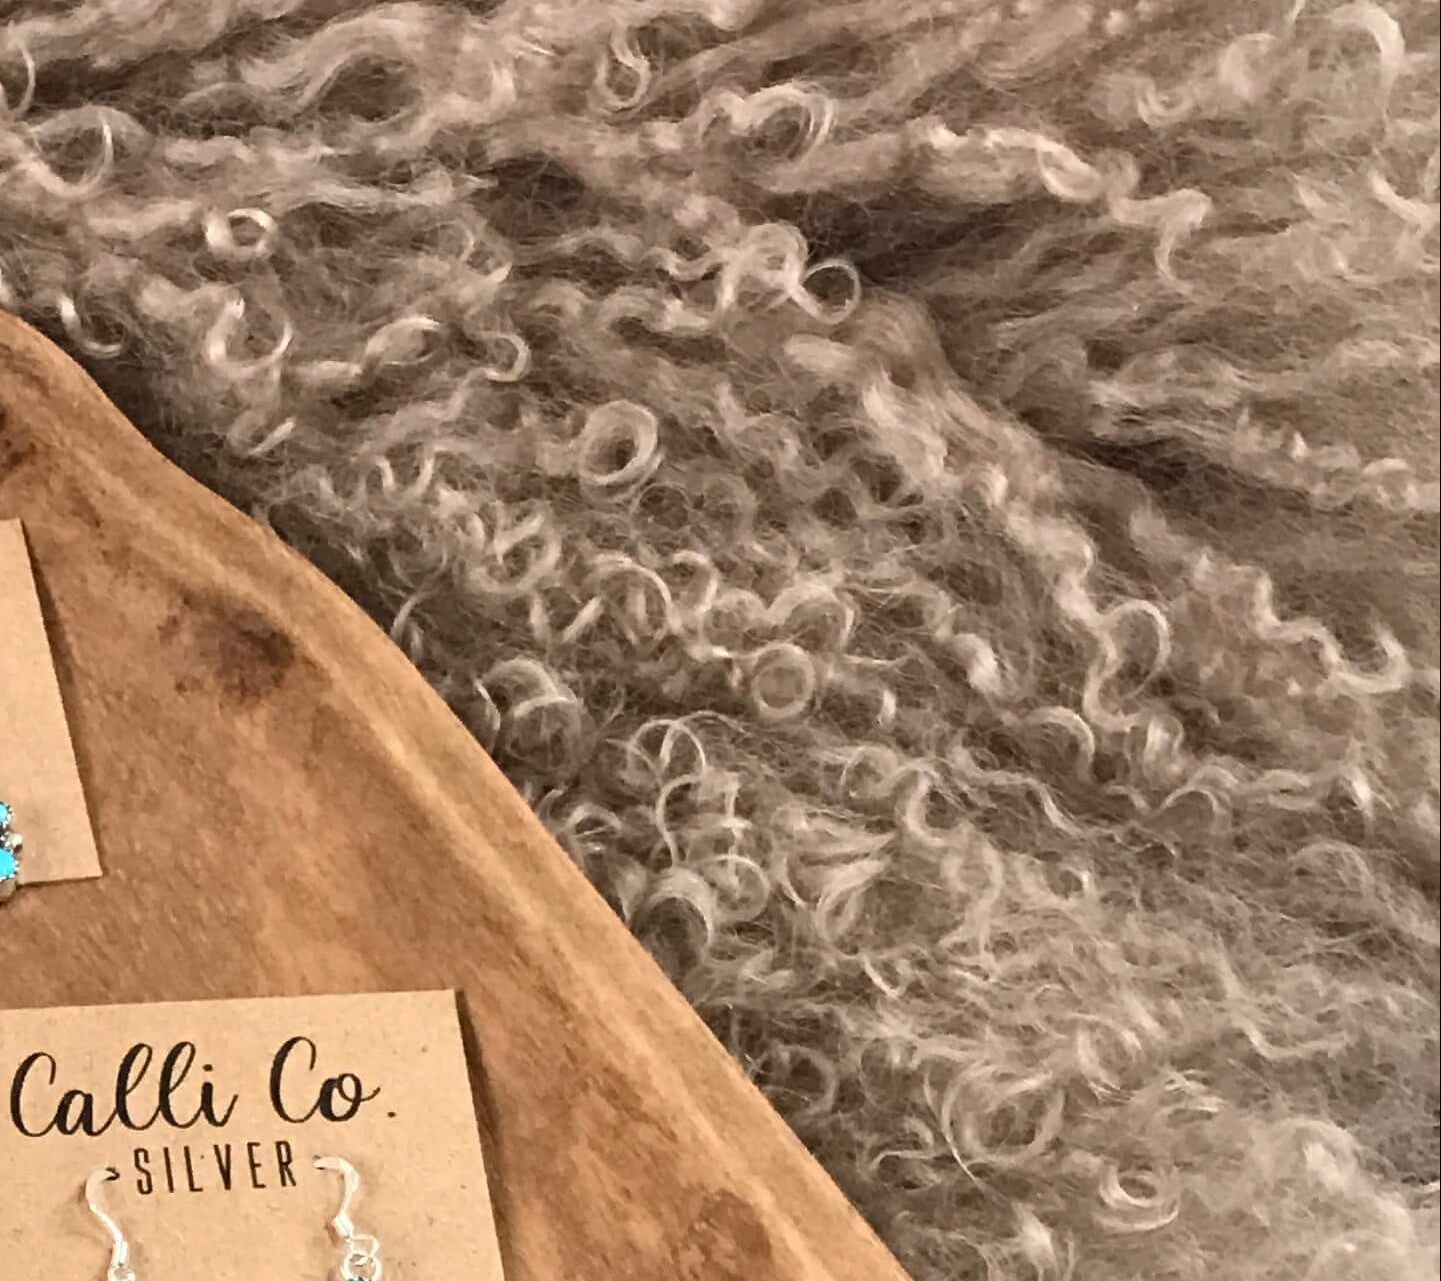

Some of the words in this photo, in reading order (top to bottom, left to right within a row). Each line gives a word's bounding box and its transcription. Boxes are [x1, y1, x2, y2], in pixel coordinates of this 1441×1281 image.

[10, 1041, 238, 1138] Calli
[270, 1035, 397, 1124] Co.
[134, 1140, 296, 1195] SILVER
